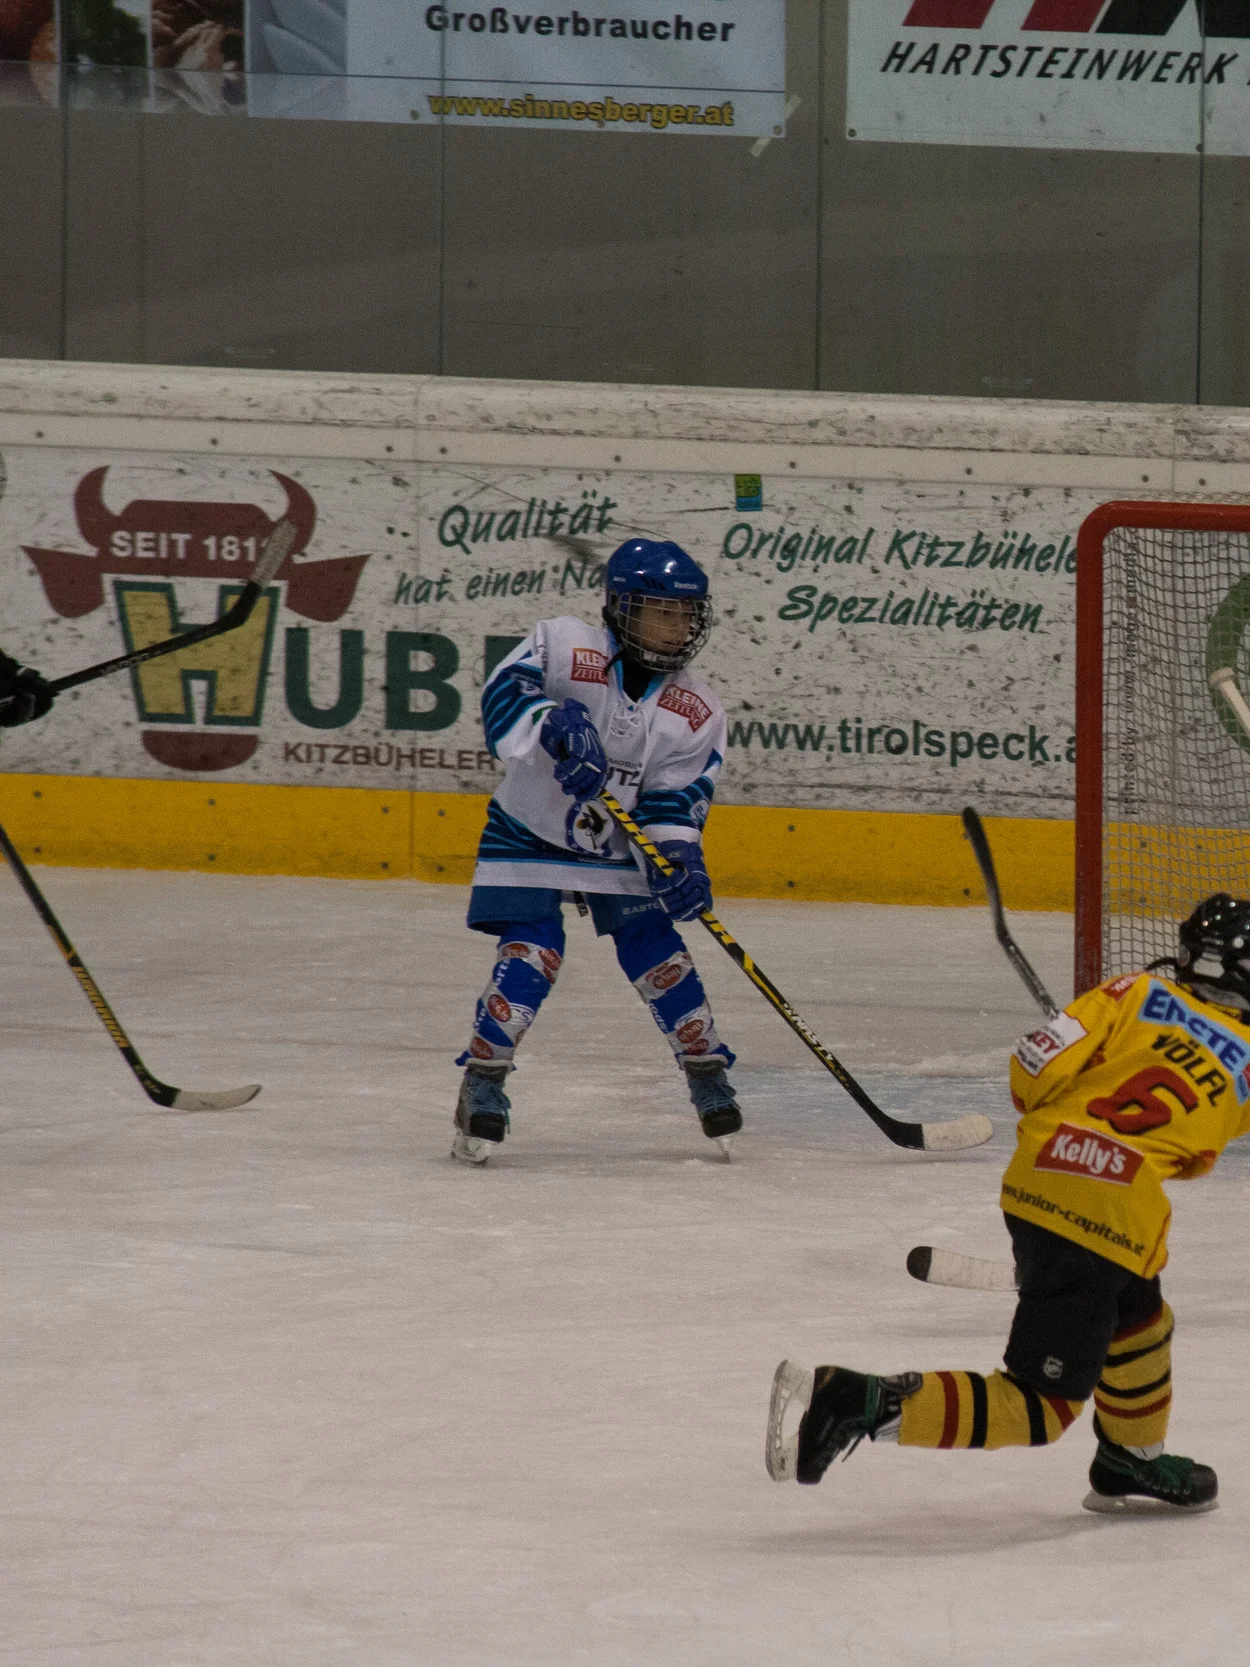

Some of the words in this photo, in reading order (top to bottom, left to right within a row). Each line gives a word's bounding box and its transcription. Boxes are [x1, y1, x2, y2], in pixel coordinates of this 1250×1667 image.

[425, 4, 736, 43] Großverbraucher
[881, 41, 1238, 86] HARTSTEINWERK
[427, 92, 735, 129] www.sinnesberger.at
[439, 489, 618, 554] Qualität
[111, 531, 191, 558] SEIT
[724, 523, 874, 572] Original
[884, 528, 1078, 574] Kitzbühele
[394, 572, 455, 604] hat
[465, 566, 547, 601] einen
[560, 556, 608, 597] Na
[779, 583, 1045, 633] Spezialitäten
[284, 742, 497, 773] KITZBÜHELER
[728, 717, 1078, 767] www.tirolspeck.a
[622, 902, 661, 915] EASTO
[1087, 1064, 1200, 1135] 6
[1051, 1133, 1126, 1174] Kelly's
